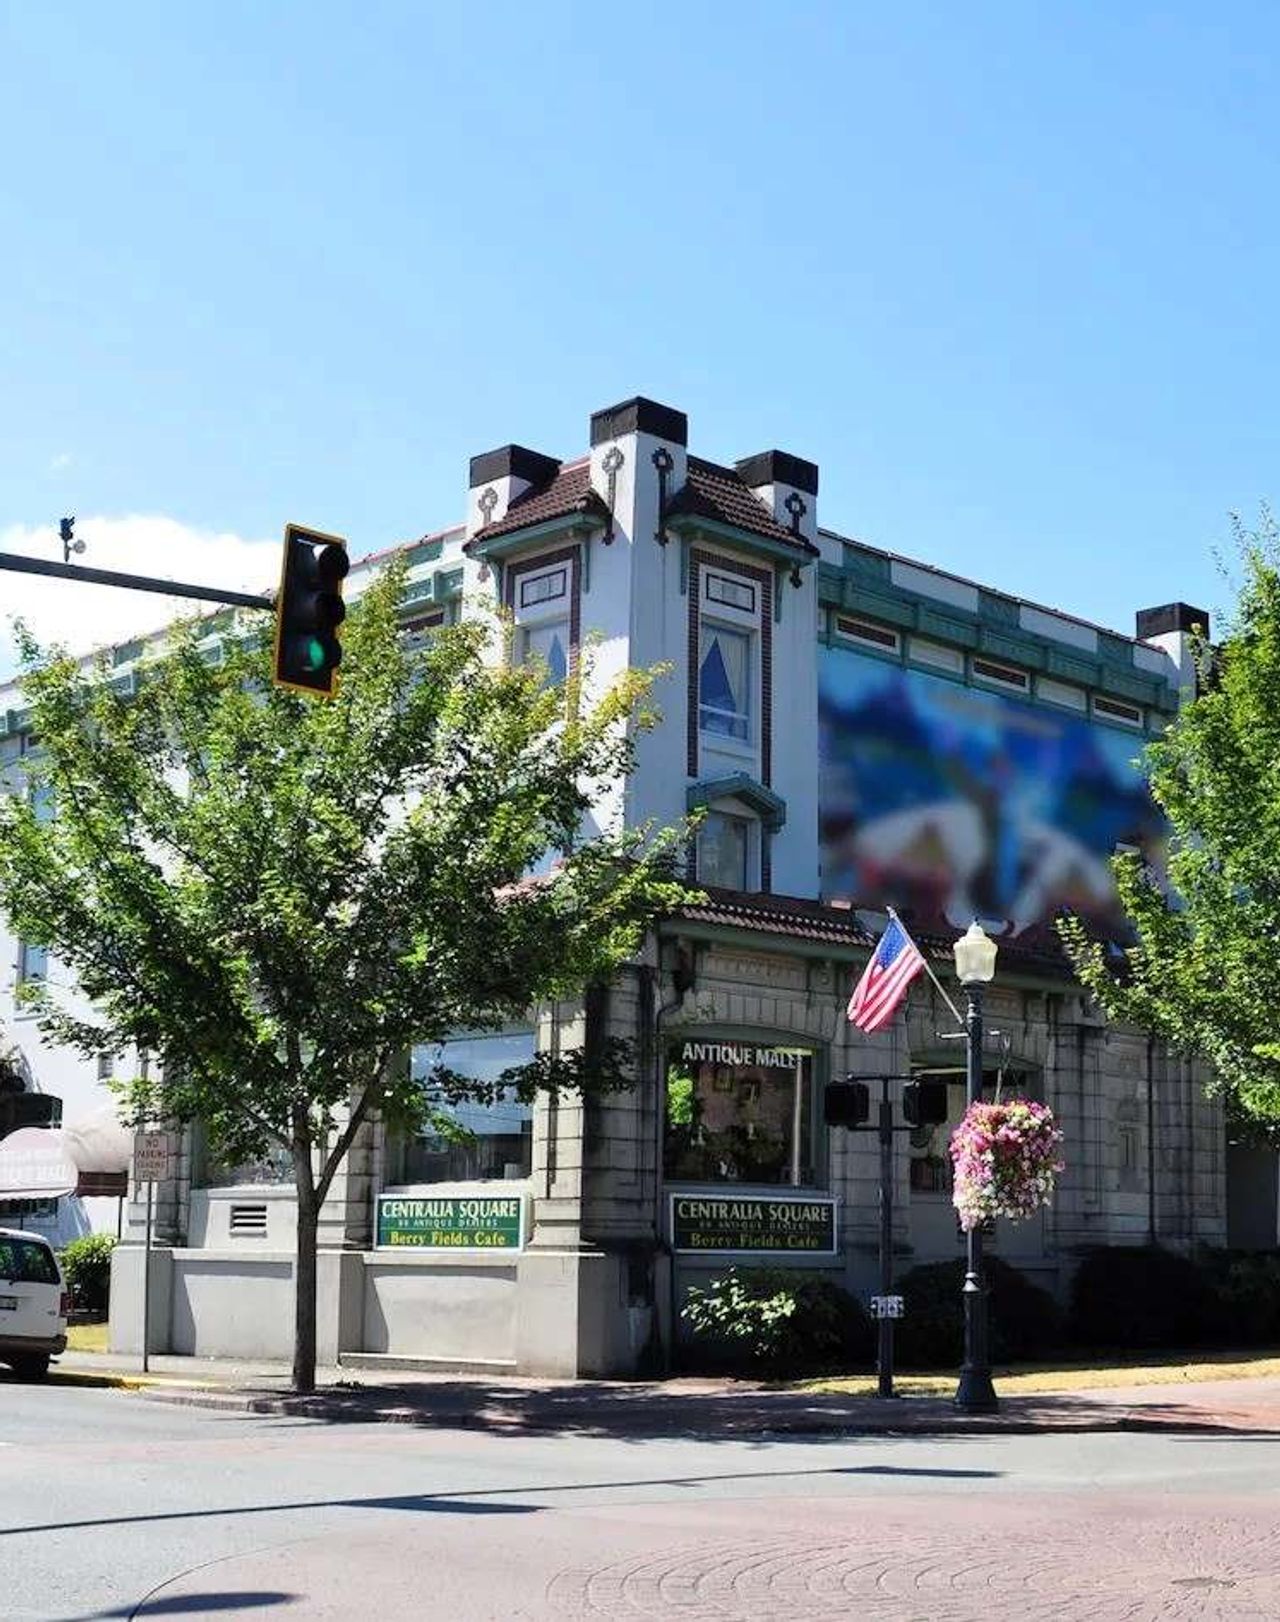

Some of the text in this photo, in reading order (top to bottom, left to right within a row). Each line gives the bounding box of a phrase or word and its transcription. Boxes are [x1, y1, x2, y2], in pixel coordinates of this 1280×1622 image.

[682, 1042, 754, 1065] ANTIQUE
[145, 1138, 159, 1148] NO
[382, 1200, 518, 1219] CENTRALIA SQUARE
[678, 1201, 829, 1224] CENTRALIA SQUARE
[390, 1231, 506, 1246] Berry Fields Cafe
[740, 1234, 782, 1248] Fields
